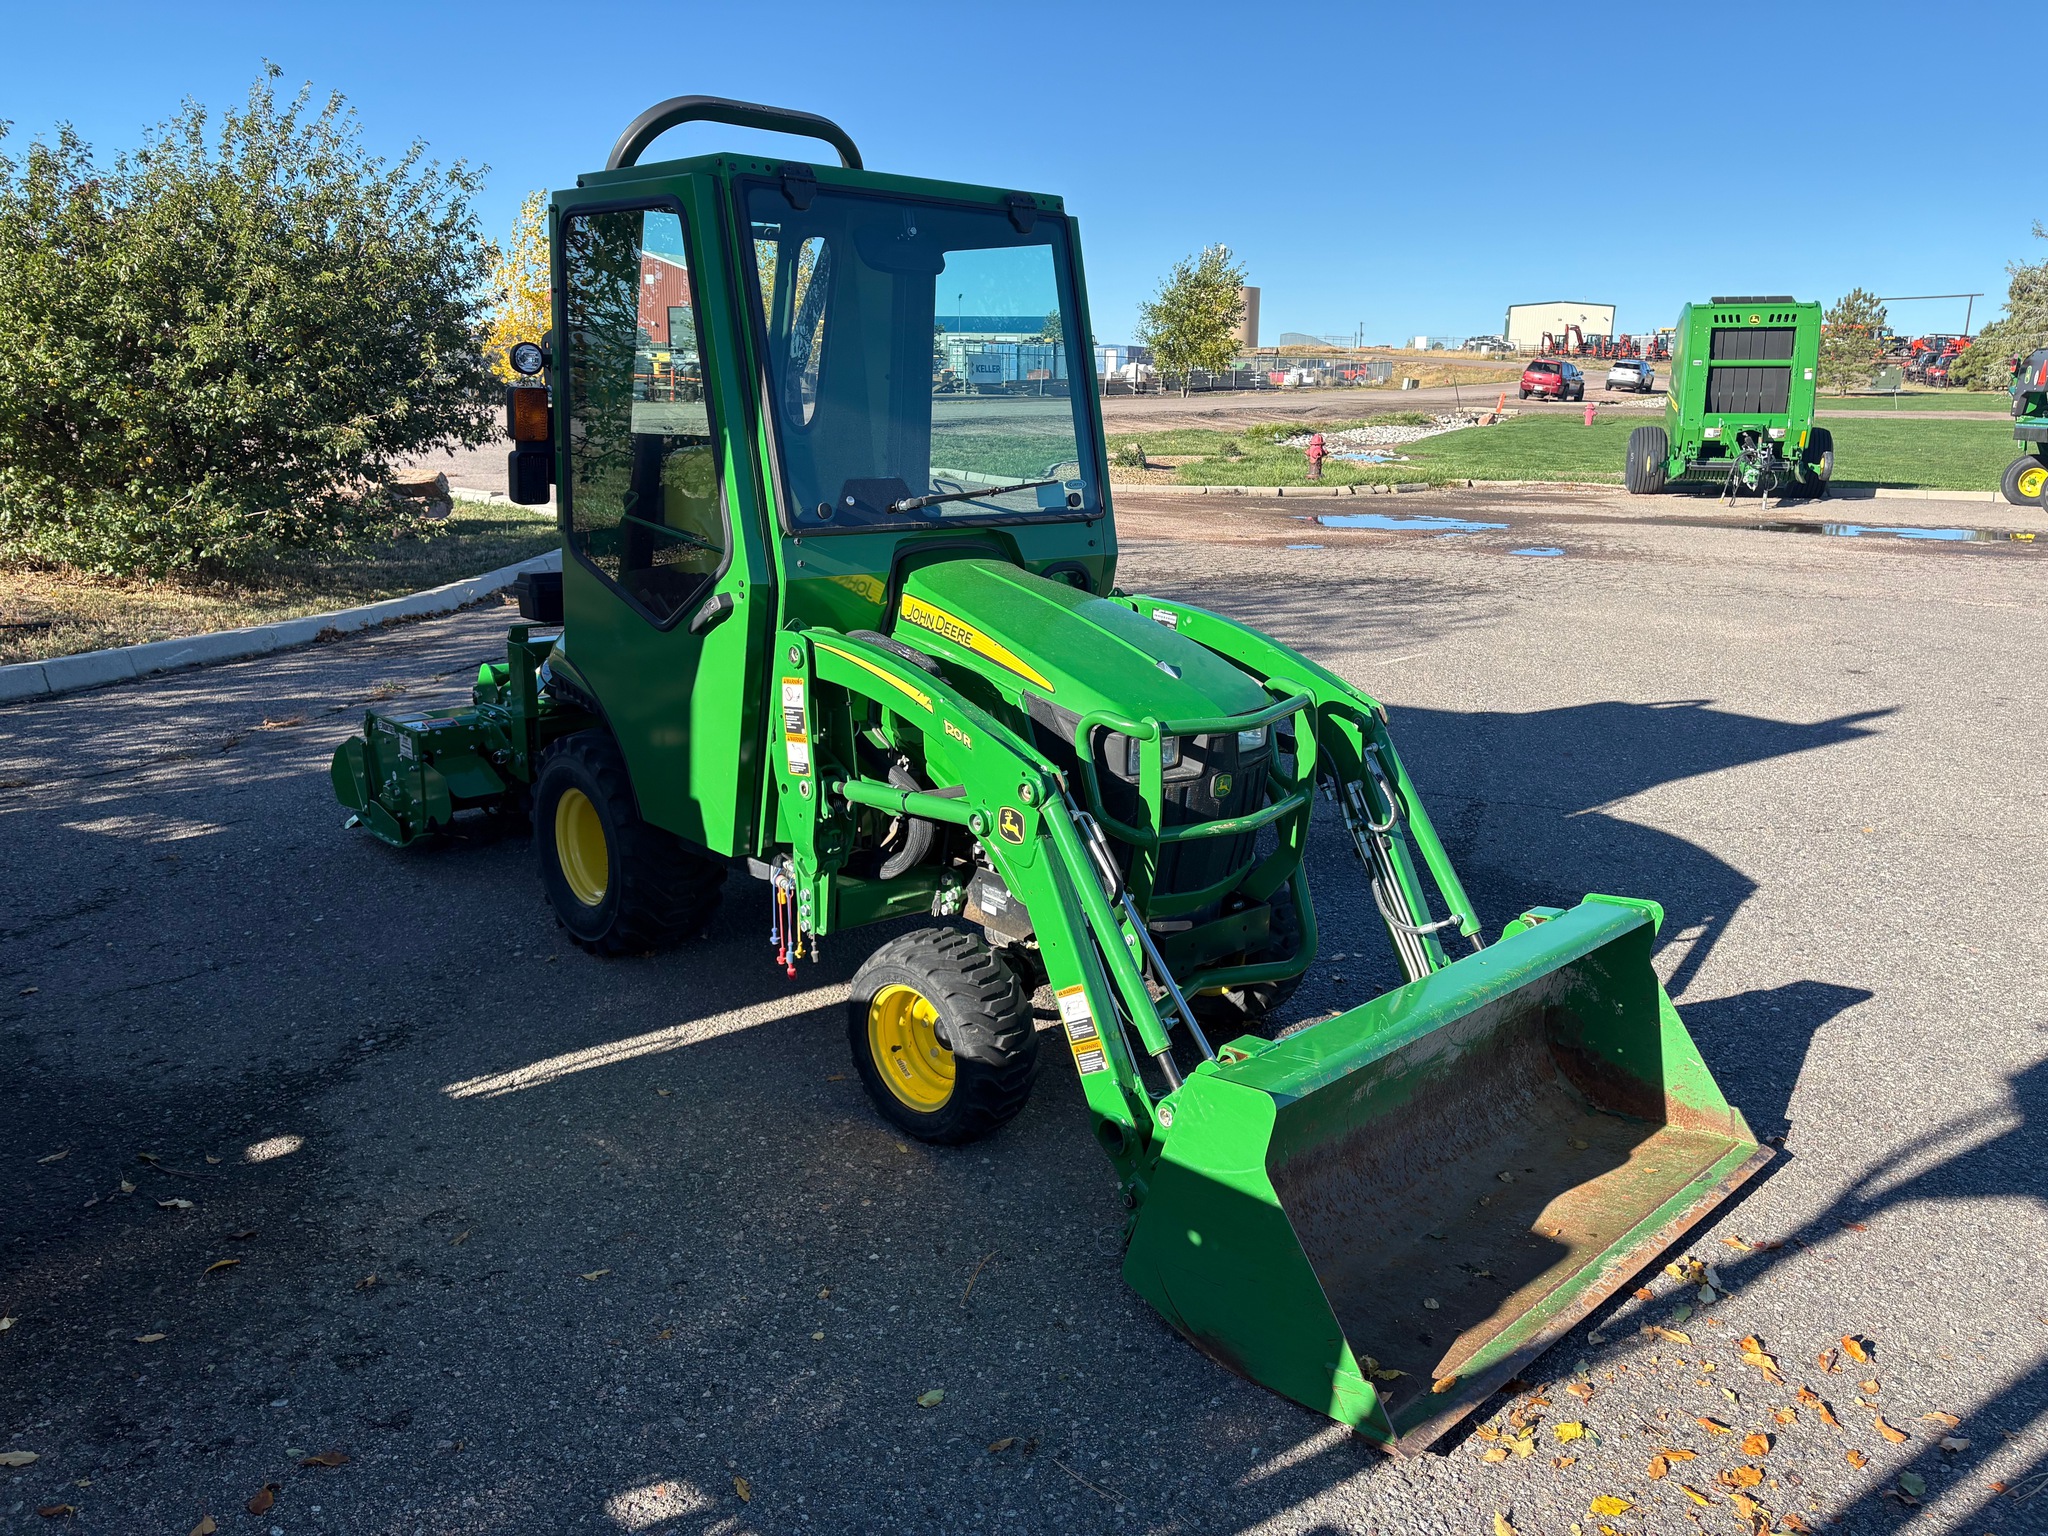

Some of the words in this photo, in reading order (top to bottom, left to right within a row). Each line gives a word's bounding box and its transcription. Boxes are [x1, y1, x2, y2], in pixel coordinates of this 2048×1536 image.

[975, 363, 1001, 374] KELLER
[906, 603, 935, 627] JOHN
[935, 615, 974, 646] DEERE
[1062, 986, 1081, 995] WARNING
[1081, 1042, 1099, 1052] WARNING
